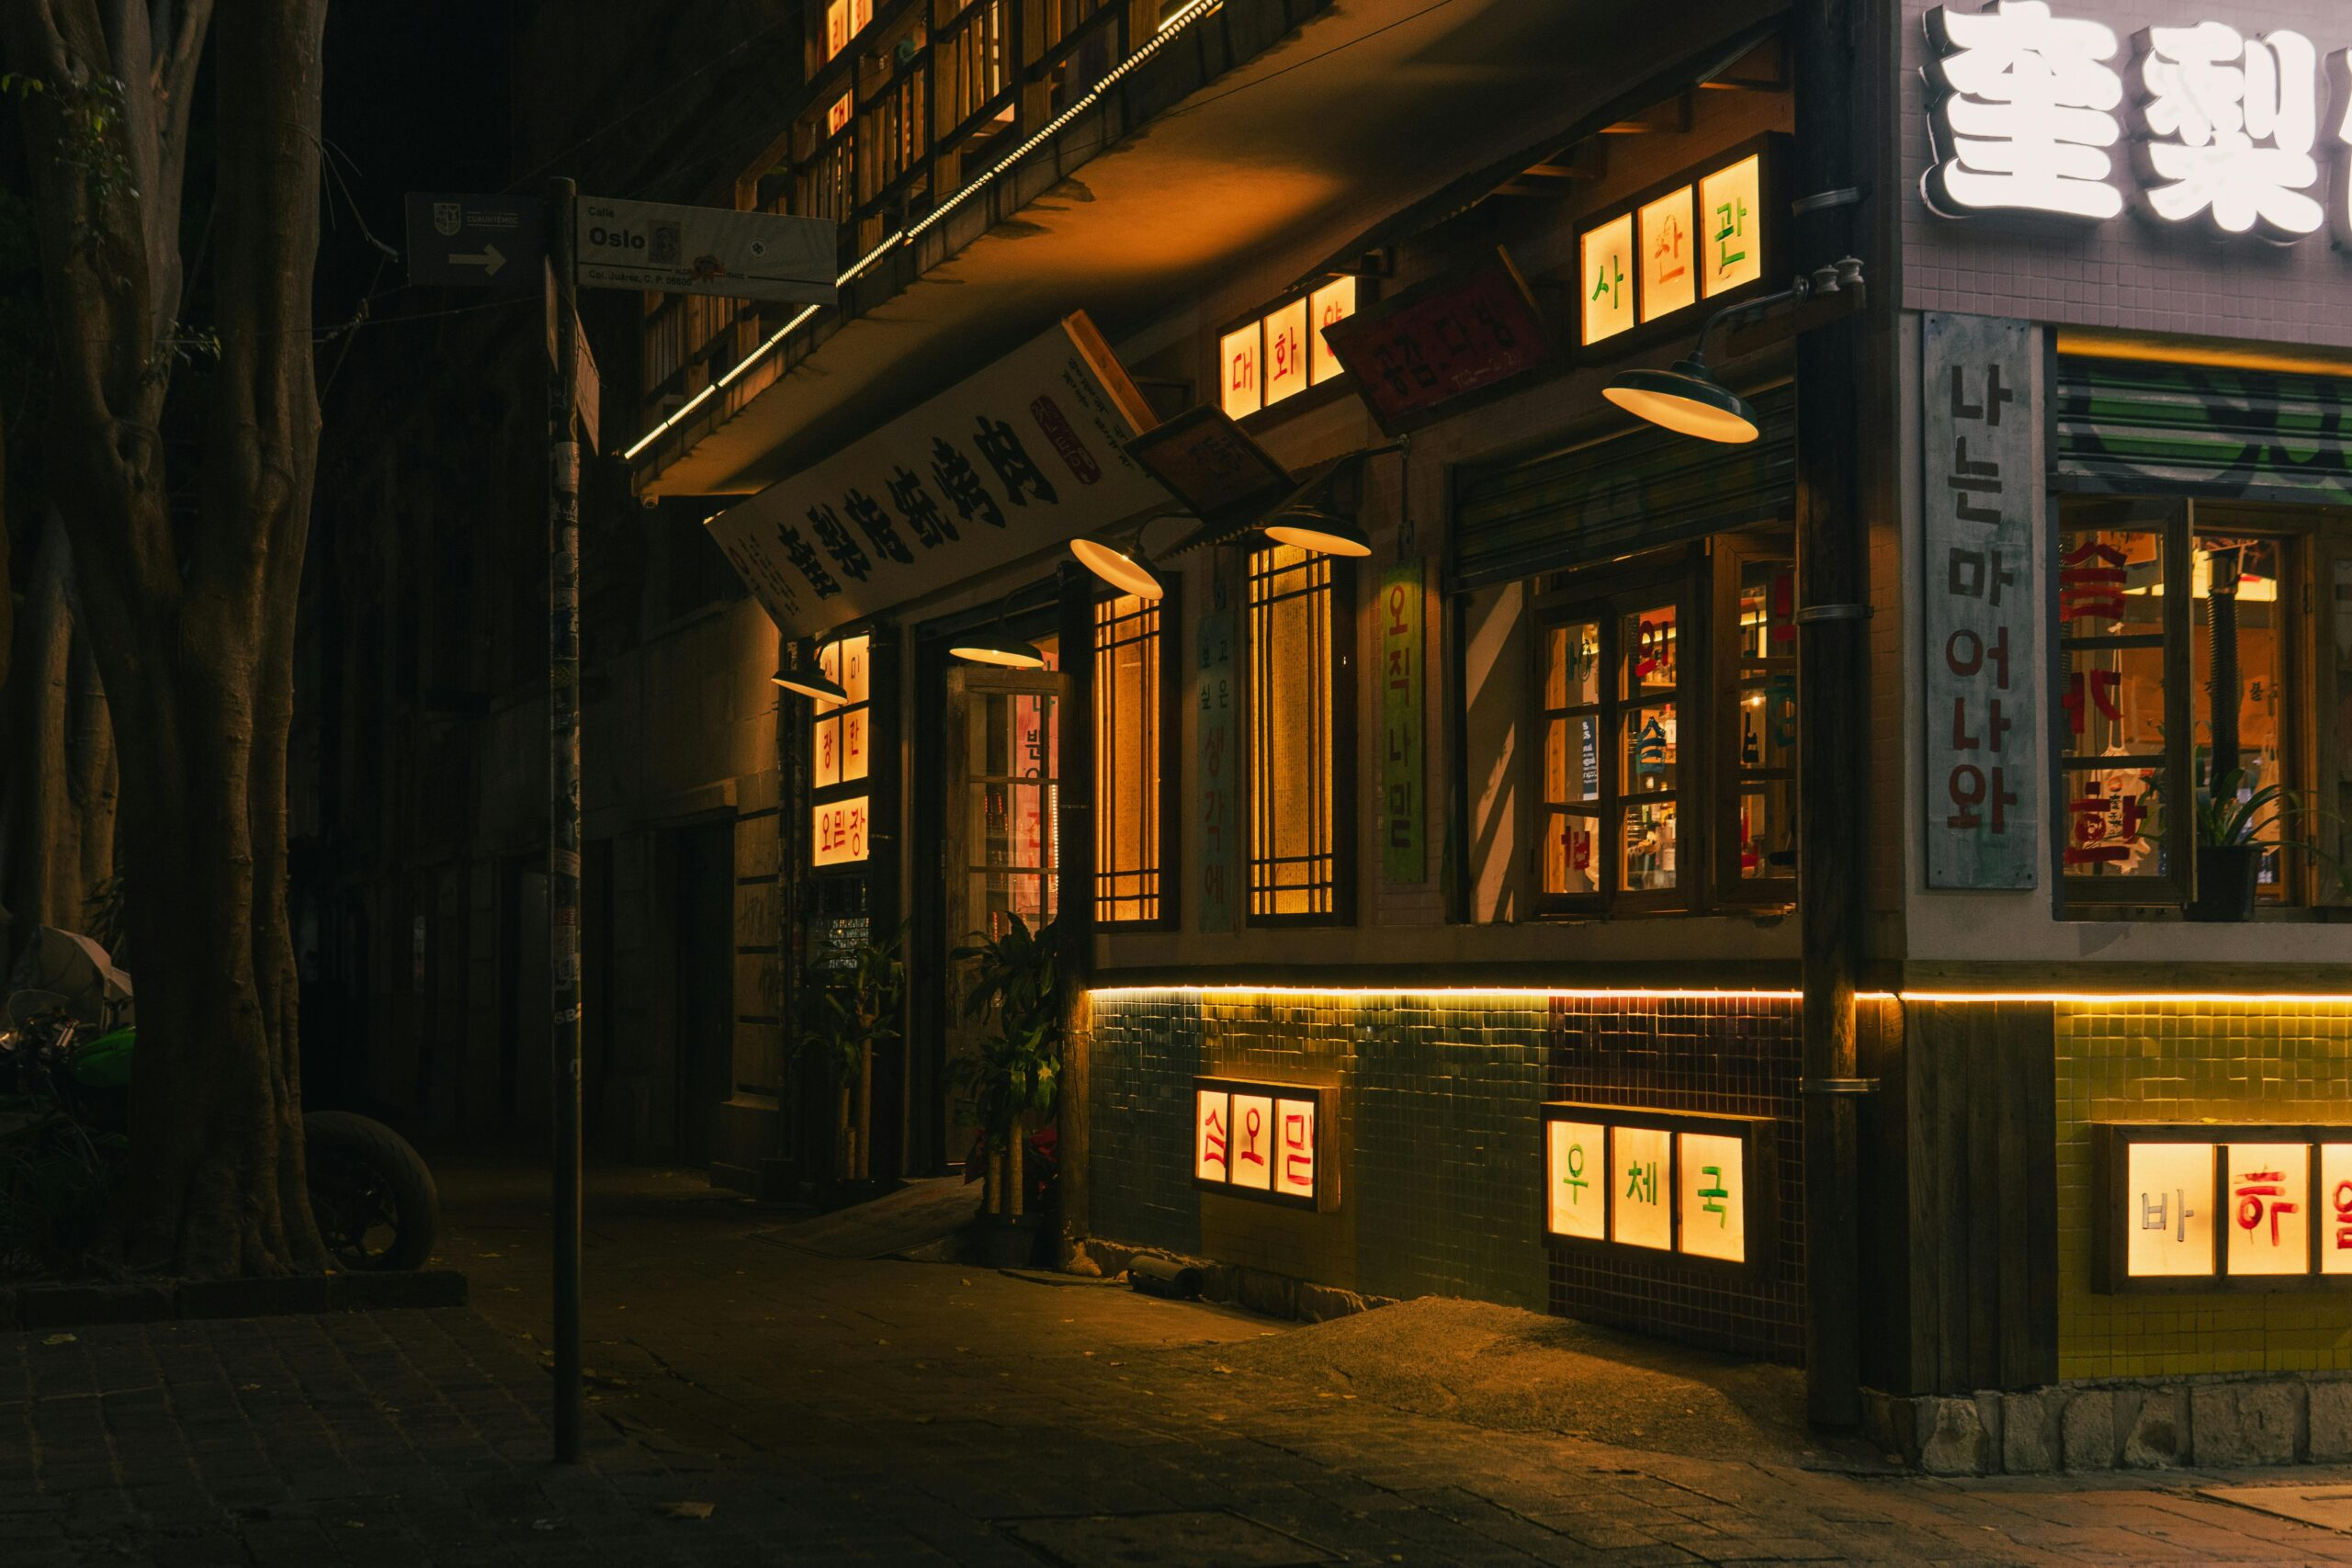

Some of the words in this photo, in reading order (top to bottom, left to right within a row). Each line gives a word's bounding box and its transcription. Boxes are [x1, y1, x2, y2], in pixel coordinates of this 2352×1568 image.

[1941, 0, 2352, 232] 奎梨
[588, 207, 615, 218] Calle
[589, 227, 645, 250] Oslo
[589, 270, 606, 279] Col.
[644, 275, 654, 283] C.
[1563, 1144, 1728, 1229] 우체국
